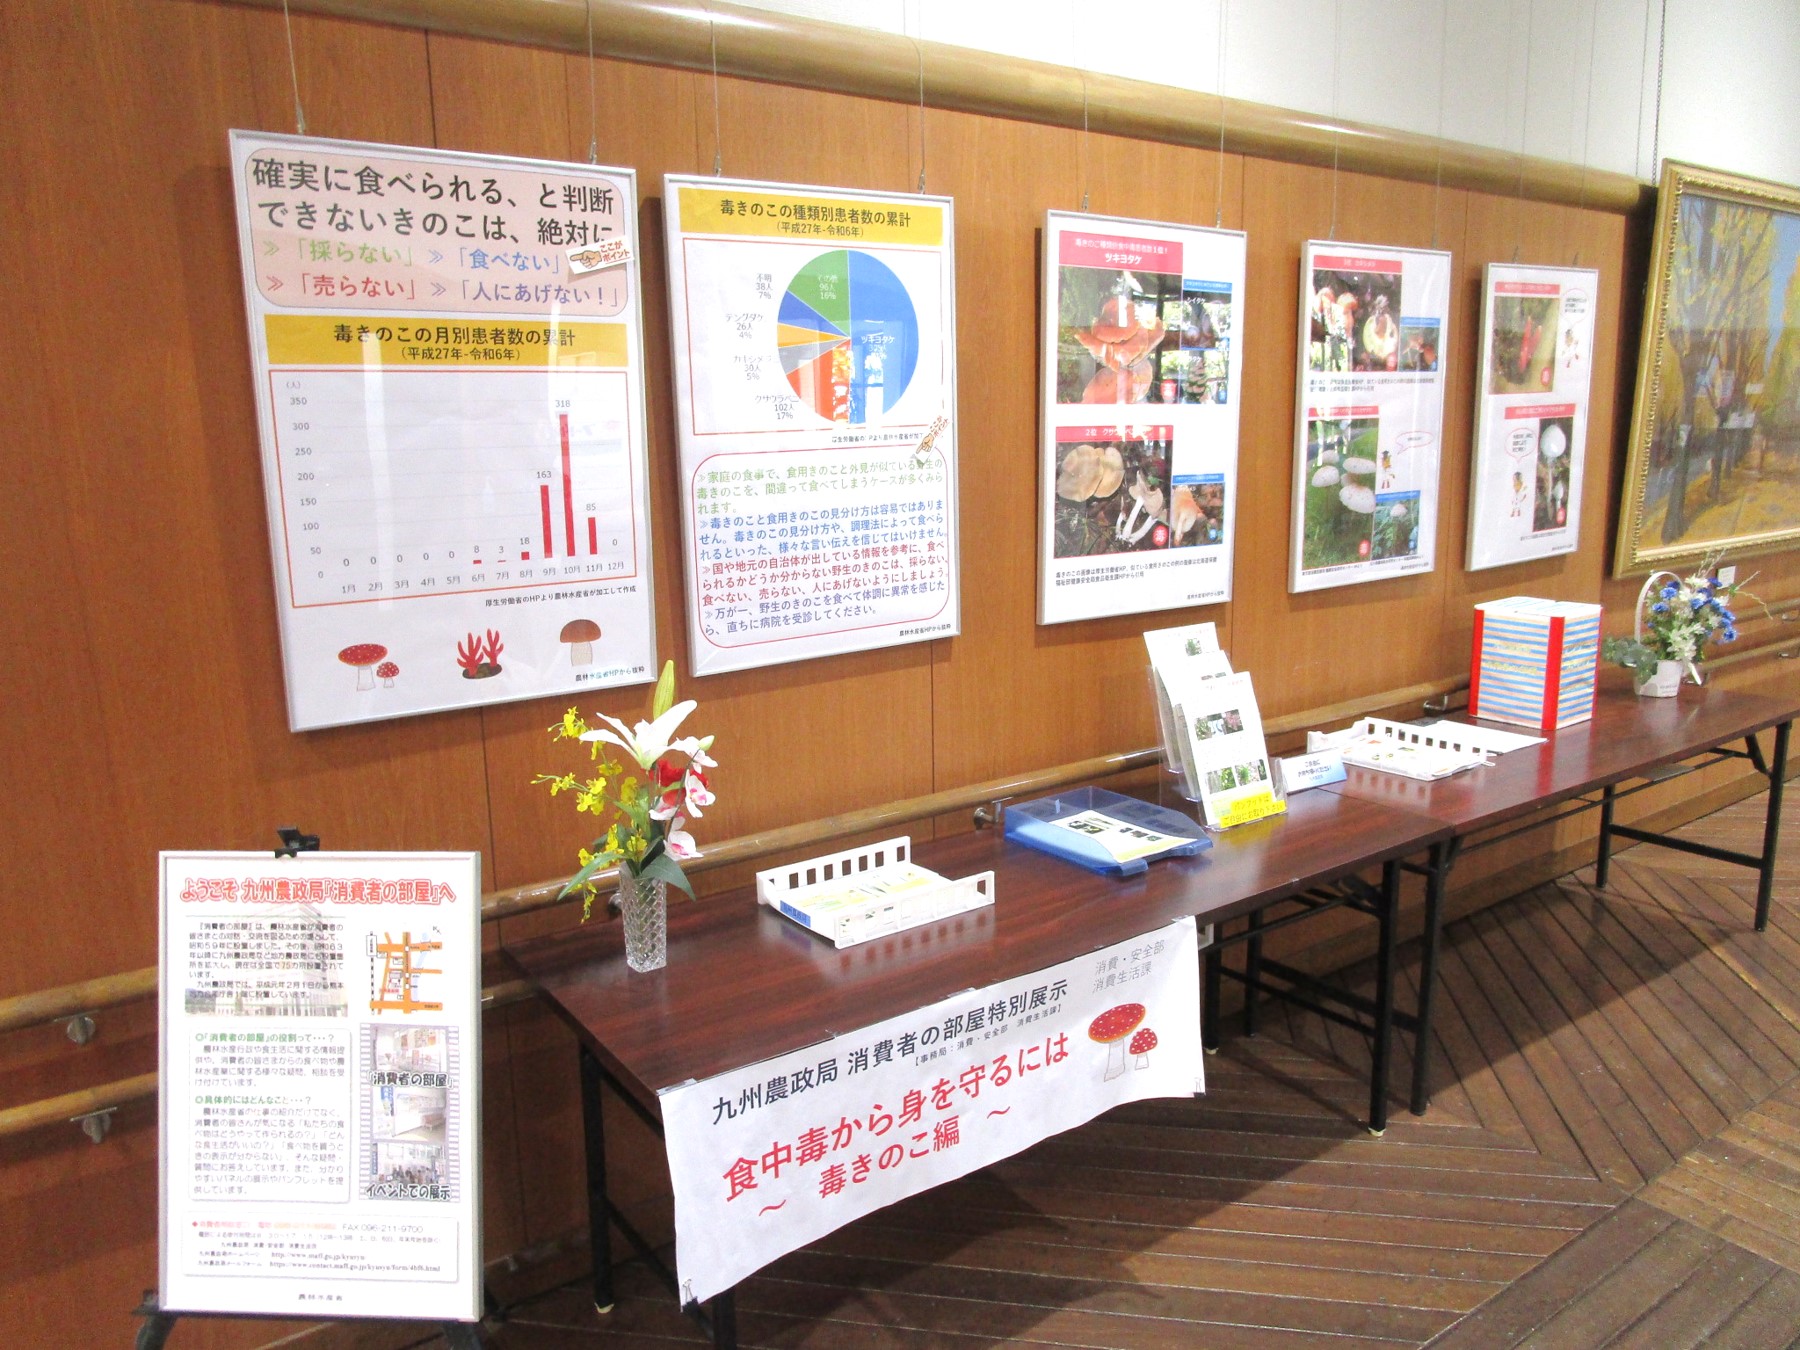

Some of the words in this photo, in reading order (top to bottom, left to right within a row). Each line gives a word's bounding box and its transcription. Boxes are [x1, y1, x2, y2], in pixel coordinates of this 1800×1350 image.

[720, 199, 911, 228] 毒きのこの種類別患者数の累計
[600, 240, 624, 255] ここが
[298, 238, 414, 267] 「採らない」
[459, 246, 560, 273] 「食べない」
[602, 247, 632, 263] ポイント
[1105, 253, 1142, 265] ツキヨタケ
[300, 272, 415, 301] 「売らない」
[736, 323, 753, 331] 26人
[333, 324, 576, 347] 毒きのこの月別患者数の累計
[290, 397, 307, 405] 350
[555, 400, 571, 408] 318
[774, 403, 795, 412] 102人
[777, 412, 793, 420] 17%
[536, 471, 552, 479] 163
[586, 503, 596, 511] 85
[520, 537, 530, 545] 18
[612, 538, 618, 546] 0
[310, 547, 321, 555] 50
[474, 545, 480, 553] 8
[498, 546, 504, 554] 3
[397, 555, 403, 563] 0
[423, 553, 429, 561] 0
[449, 551, 455, 559] 0
[343, 559, 350, 567] 0
[371, 557, 377, 565] 0
[608, 561, 625, 571] 12月
[543, 567, 556, 577] 9月
[564, 564, 581, 575] 10月
[586, 563, 603, 573] 11月
[471, 572, 485, 583] 6月
[496, 571, 509, 581] 7月
[519, 569, 533, 579] 8月
[395, 580, 409, 589] 3月
[421, 577, 435, 587] 4月
[446, 574, 460, 585] 5月
[342, 584, 356, 593] 1月
[368, 582, 383, 591] 2月
[181, 878, 238, 902] ようこそ
[1093, 960, 1152, 993] 消費生活課
[712, 1059, 840, 1126] 九州農政局
[847, 978, 1069, 1076] 消費者の部屋特別展示
[723, 1031, 1070, 1202] 食中毒から身を守るには
[818, 1116, 961, 1199] 毒きのこ編
[366, 1184, 451, 1200] イベントでの展示
